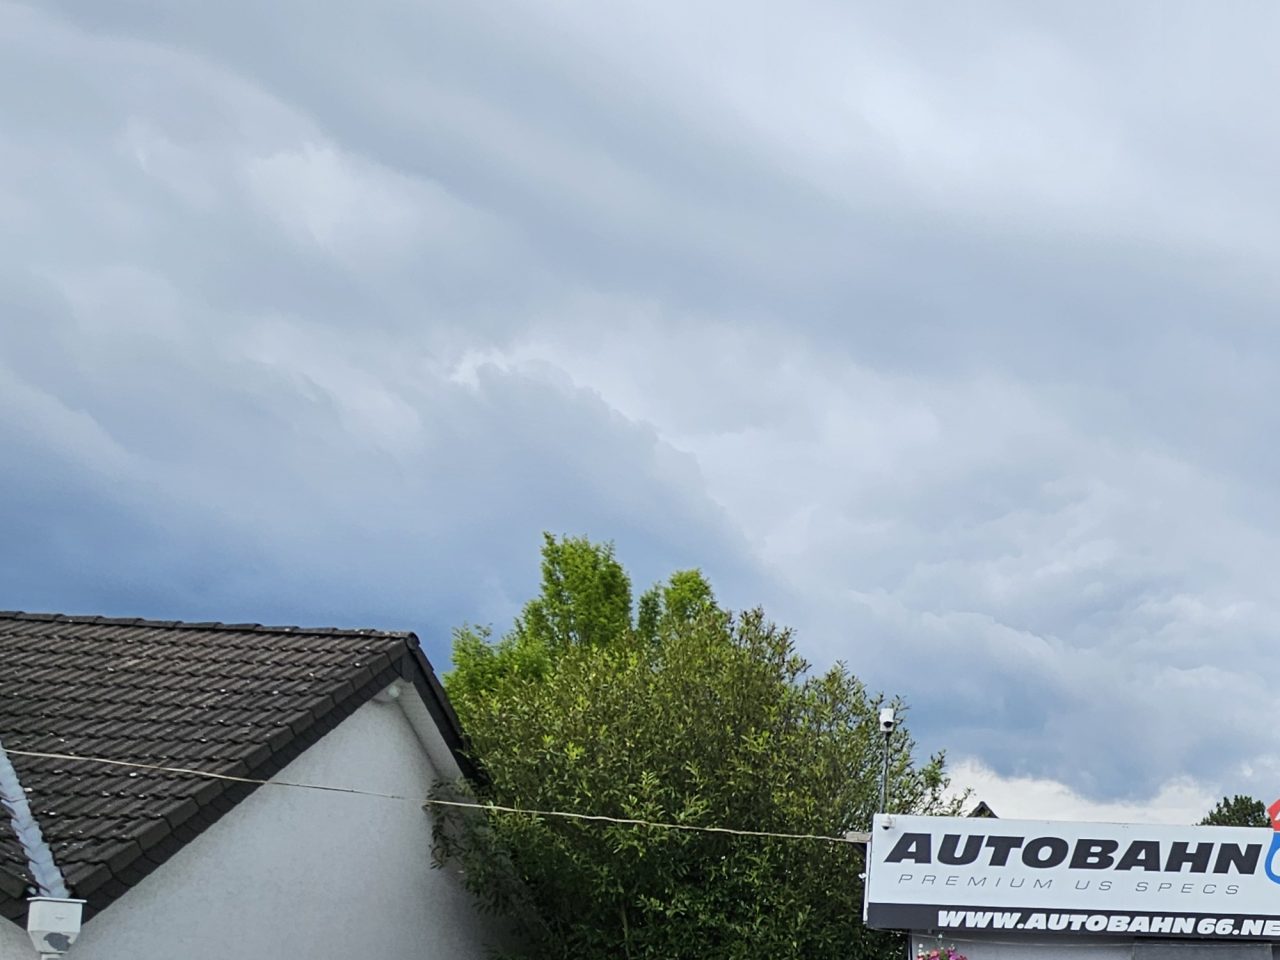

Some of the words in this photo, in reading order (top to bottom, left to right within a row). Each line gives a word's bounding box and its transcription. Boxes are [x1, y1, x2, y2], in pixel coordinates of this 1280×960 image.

[884, 832, 1263, 875] AUTOBAHN
[898, 874, 1053, 889] PREMIUM
[1075, 880, 1113, 891] US
[1135, 881, 1240, 895] SPECS
